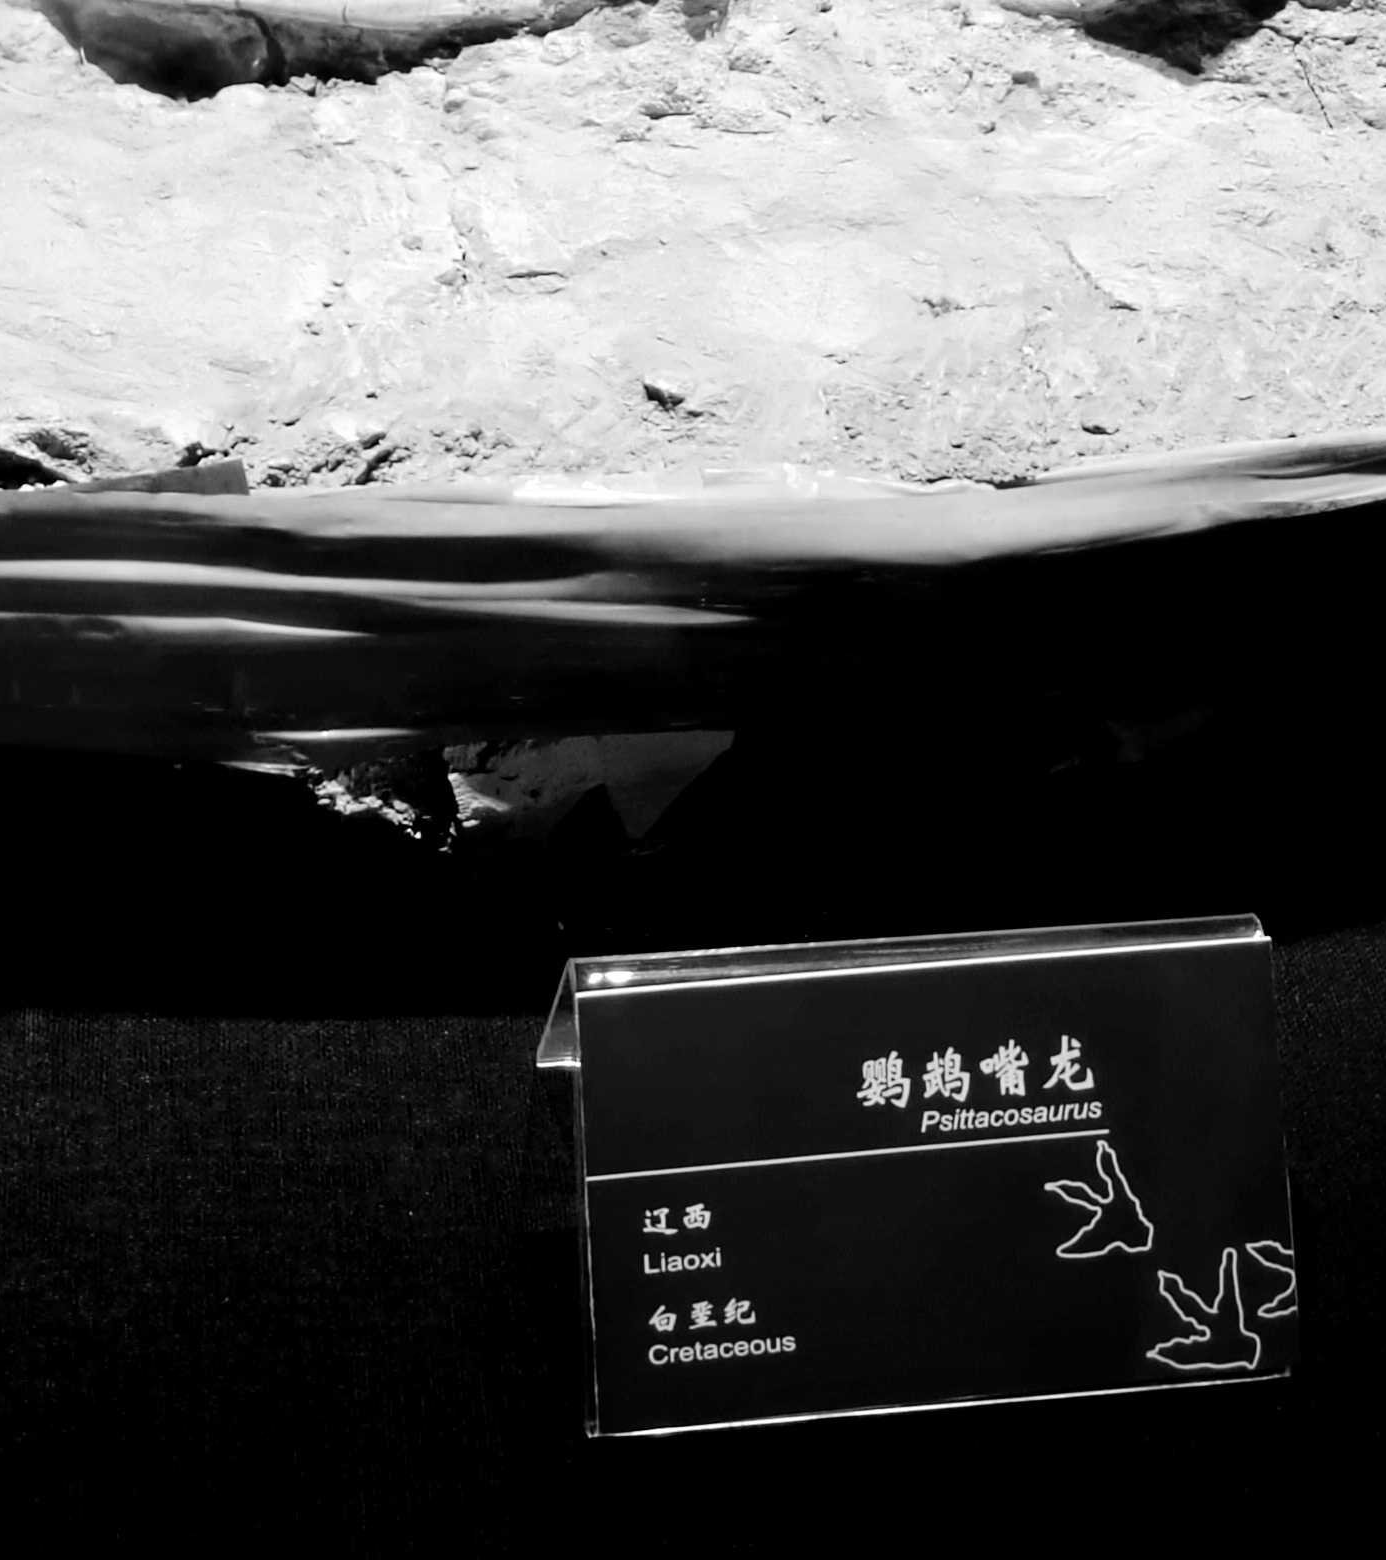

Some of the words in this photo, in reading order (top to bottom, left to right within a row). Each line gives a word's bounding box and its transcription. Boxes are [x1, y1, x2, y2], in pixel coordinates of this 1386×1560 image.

[856, 1034, 1095, 1109] 鹦鹉嘴龙
[920, 1101, 1103, 1133] Psittacosaurus
[642, 1203, 712, 1235] 辽西
[643, 1247, 722, 1275] Liaoxi
[648, 1297, 756, 1332] 白垩纪
[648, 1336, 796, 1365] Cretaceous
